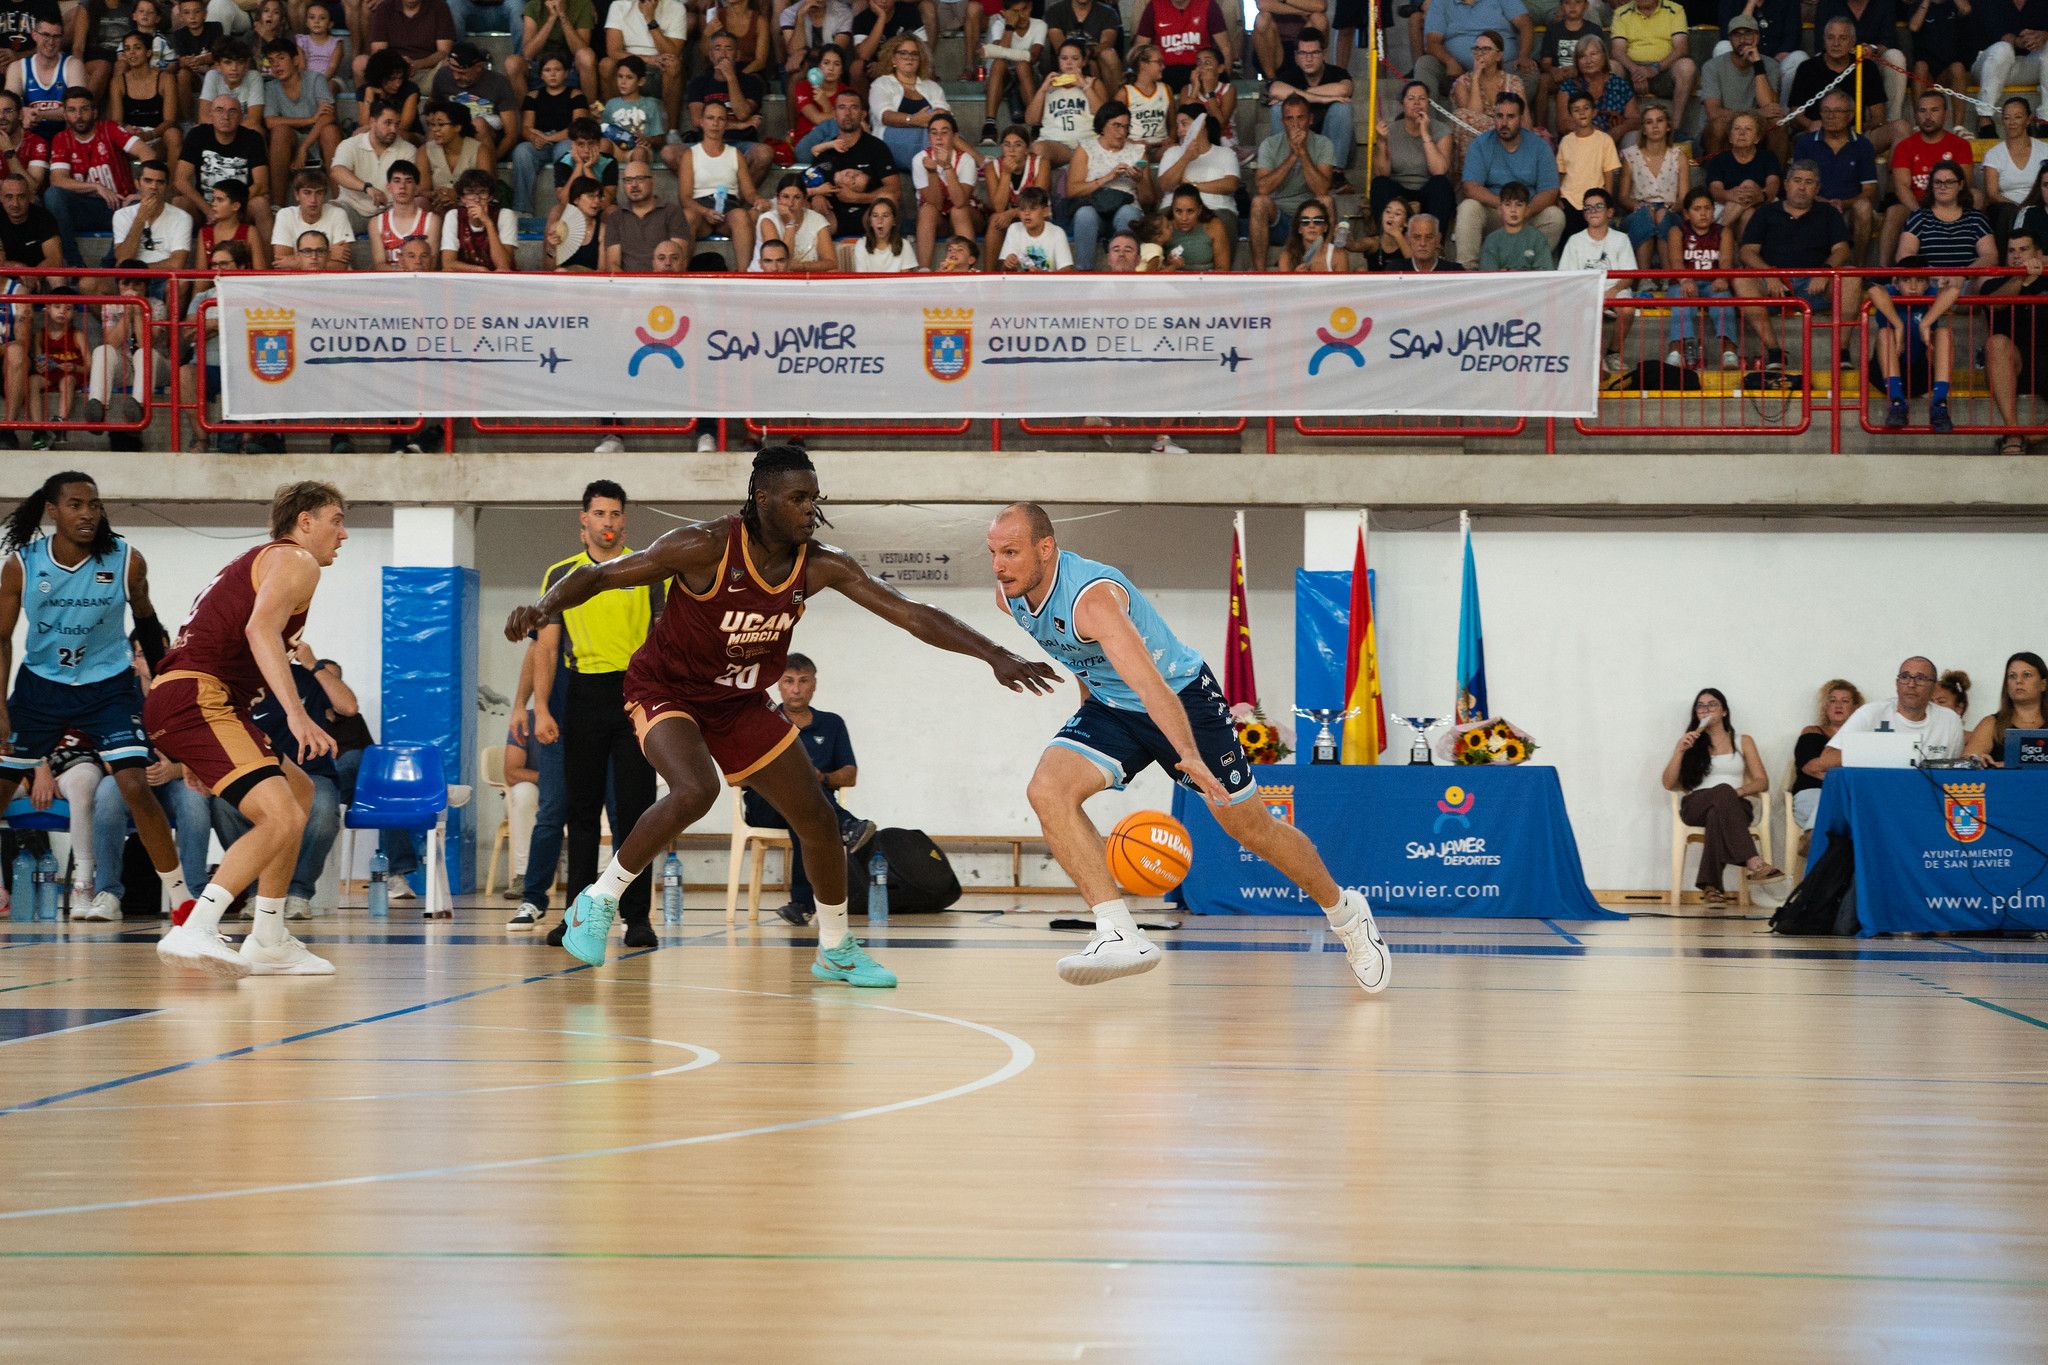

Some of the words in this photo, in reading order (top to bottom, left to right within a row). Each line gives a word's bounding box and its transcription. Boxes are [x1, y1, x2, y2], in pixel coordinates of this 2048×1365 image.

[1161, 31, 1201, 48] UCAM
[1049, 98, 1086, 114] UCAM
[1135, 109, 1164, 120] UCAM
[1062, 115, 1075, 131] 15
[1142, 123, 1158, 138] 27
[1684, 249, 1719, 260] UCAM
[311, 317, 448, 330] AYUNTAMIENTO
[454, 317, 476, 329] DE
[482, 317, 518, 329] SAN
[524, 316, 588, 329] JAVIER
[990, 317, 1128, 330] AYUNTAMIENTO
[1135, 317, 1156, 329] DE
[1163, 317, 1200, 329] SAN
[1206, 316, 1271, 329] JAVIER
[310, 336, 406, 352] CIUDAD
[417, 336, 462, 352] DEL
[473, 336, 534, 352] AIRE
[707, 329, 760, 361] SAN
[765, 321, 856, 359] JAVIER
[988, 336, 1086, 352] CIUDAD
[1097, 336, 1141, 352] DEL
[1153, 336, 1215, 352] AIRE
[1389, 328, 1443, 359] SAN
[1447, 319, 1541, 357] JAVIER
[778, 357, 885, 374] DEPORTES
[1461, 355, 1569, 373] DEPORTES
[880, 552, 923, 564] VESTUARIO
[925, 552, 931, 564] 5
[897, 569, 941, 581] VESTUARIO
[719, 610, 796, 633] UCAM
[727, 630, 781, 647] MURCIA
[58, 646, 86, 668] 25
[714, 663, 761, 690] 20
[2021, 744, 2043, 755] liga
[1150, 826, 1193, 864] Wilson
[1405, 841, 1436, 859] SAN
[1436, 836, 1487, 858] JAVIER
[1240, 853, 1254, 862] DE
[1443, 855, 1502, 866] DEPORTES
[1922, 848, 2014, 860] AYUNTAMIENTO
[1925, 860, 1940, 870] DE
[1944, 859, 1969, 870] SAN
[1973, 858, 2012, 869] JAVIER
[1925, 887, 2046, 914] www.pdm
